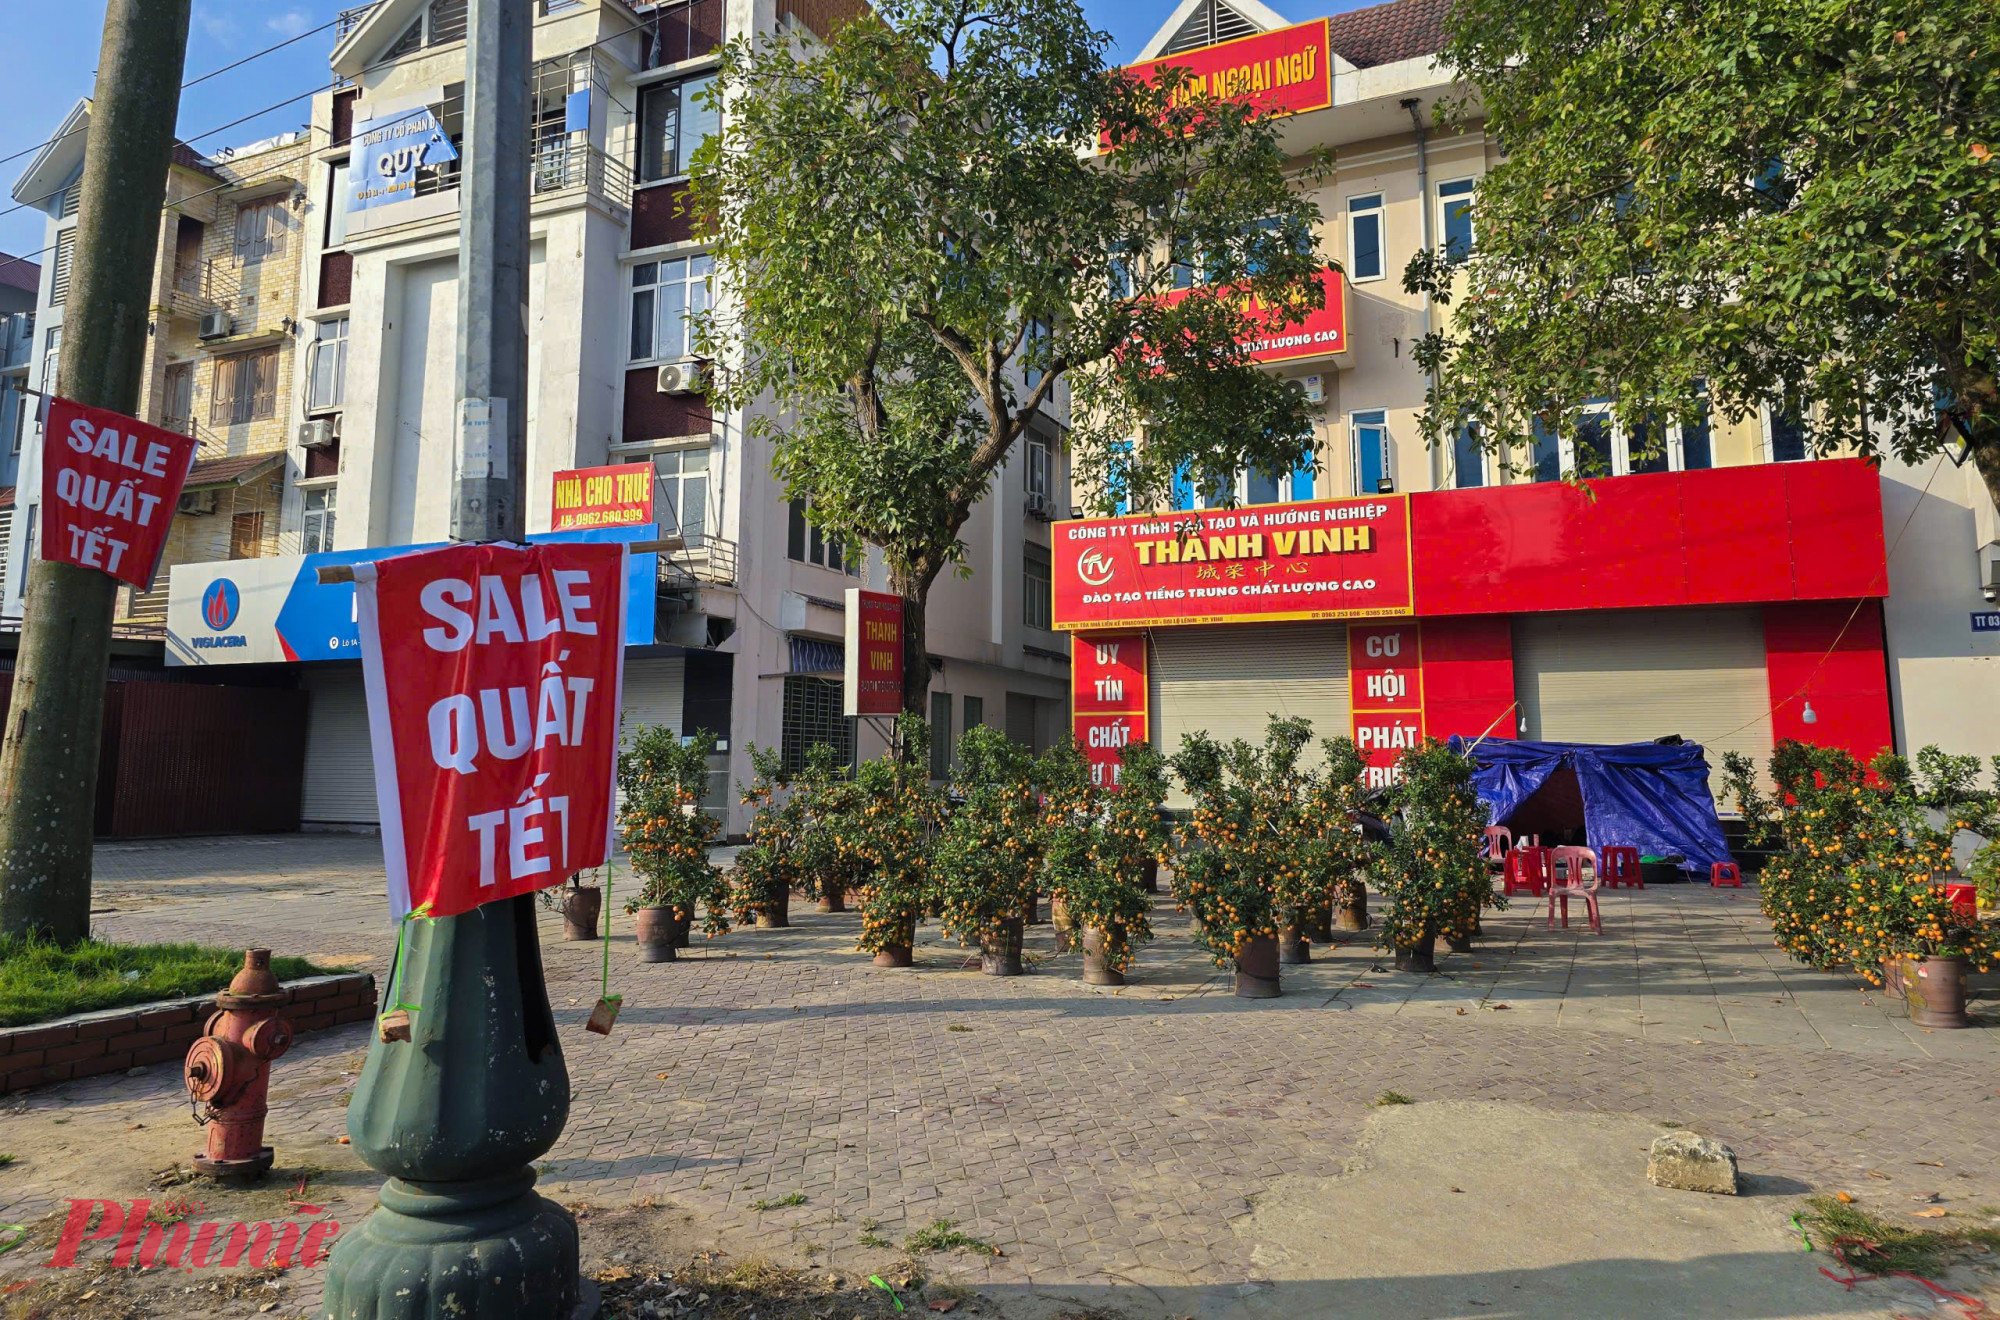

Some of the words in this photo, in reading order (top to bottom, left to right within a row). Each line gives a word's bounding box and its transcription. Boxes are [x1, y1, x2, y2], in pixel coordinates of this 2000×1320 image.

[1276, 45, 1318, 88] NGỮ
[1271, 332, 1312, 350] LƯỢNG
[1314, 329, 1338, 343] CAO
[67, 418, 171, 478] SALE
[56, 467, 162, 527] QUẤT
[555, 474, 583, 509] NHÀ
[585, 475, 613, 507] CHO
[616, 466, 650, 504] THUÊ
[576, 508, 643, 526] 0962.680.999
[1068, 526, 1107, 540] CÔNG
[1110, 525, 1127, 538] TY
[1131, 522, 1170, 536] TNHH
[1208, 516, 1236, 531] TẠO
[1240, 512, 1259, 528] VÀ
[1264, 509, 1321, 526] HƯỚNG
[1324, 503, 1388, 521] NGHIỆP
[67, 523, 129, 574] TẾT
[1134, 530, 1264, 566] THÀNH
[1272, 525, 1371, 556] VINH
[1083, 590, 1112, 604] ĐÀO
[1114, 592, 1142, 605] TẠO
[1145, 585, 1186, 601] TIẾNG
[1188, 586, 1239, 599] TRUNG
[1241, 580, 1281, 596] CHẤT
[1283, 580, 1340, 596] LƯỢNG
[1342, 579, 1377, 592] CAO
[419, 569, 598, 653] SALE
[1975, 616, 1986, 627] TT
[191, 635, 247, 649] VIGLACERA
[865, 619, 898, 642] THÀNH
[1366, 633, 1401, 658] CƠ
[870, 650, 893, 671] VINH
[1096, 644, 1120, 665] UY
[1095, 675, 1123, 701] TÍN
[1367, 668, 1406, 702] HỘI
[426, 649, 595, 776] QUẤT
[1088, 718, 1130, 748] CHẤT
[1357, 720, 1417, 749] PHÁT
[467, 772, 570, 888] TẾT
